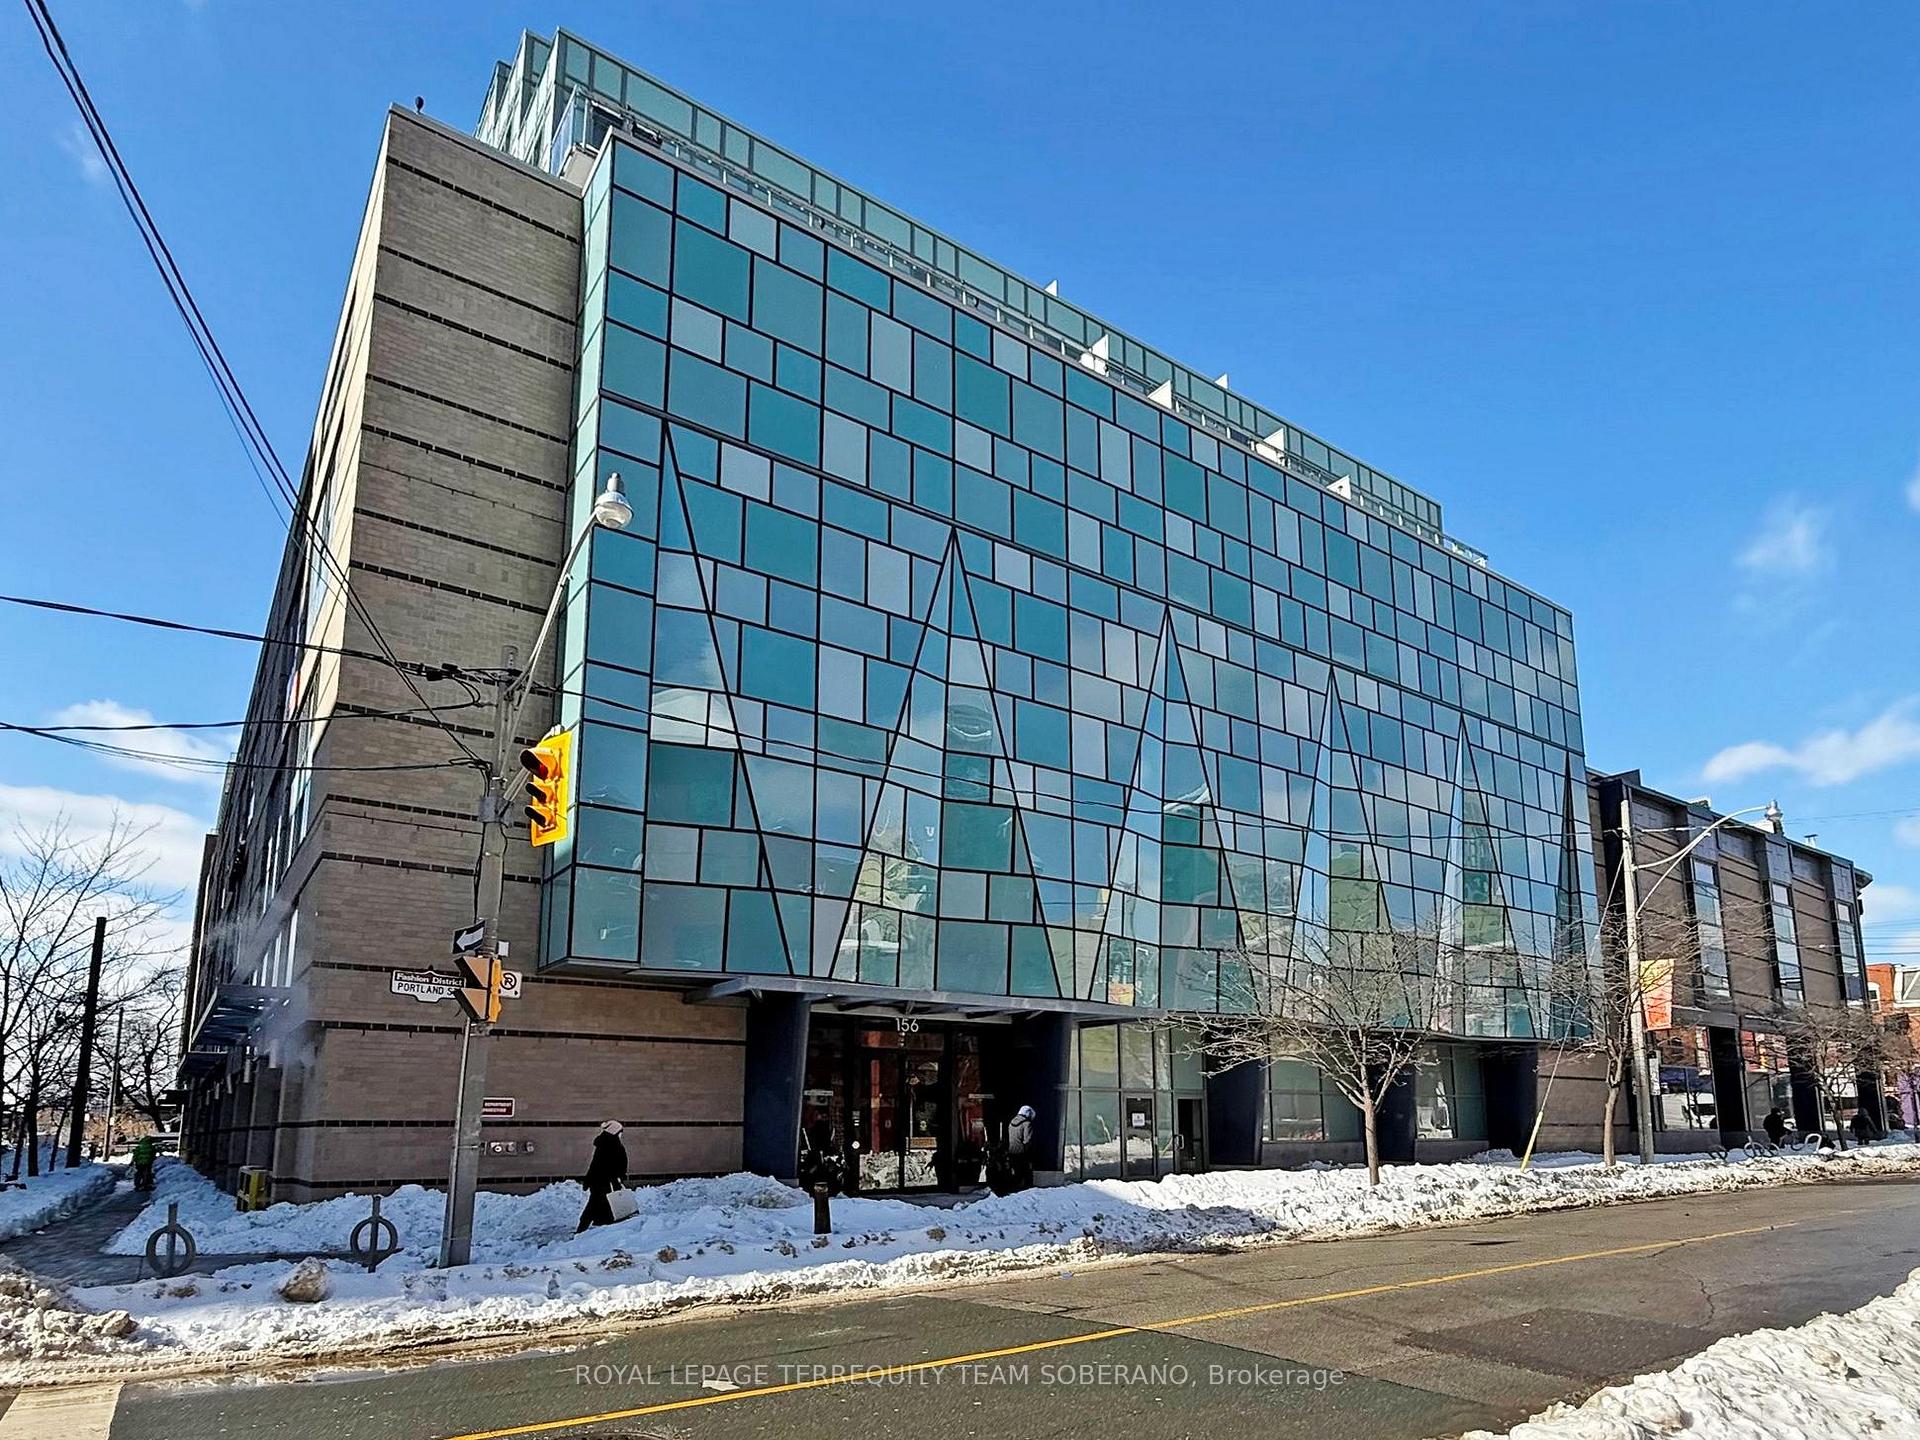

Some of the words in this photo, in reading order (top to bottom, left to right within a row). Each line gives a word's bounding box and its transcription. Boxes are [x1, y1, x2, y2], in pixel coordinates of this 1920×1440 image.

[396, 973, 430, 983] Fashion
[431, 976, 463, 986] District
[397, 982, 445, 996] PORTLAND
[895, 1017, 919, 1033] 156
